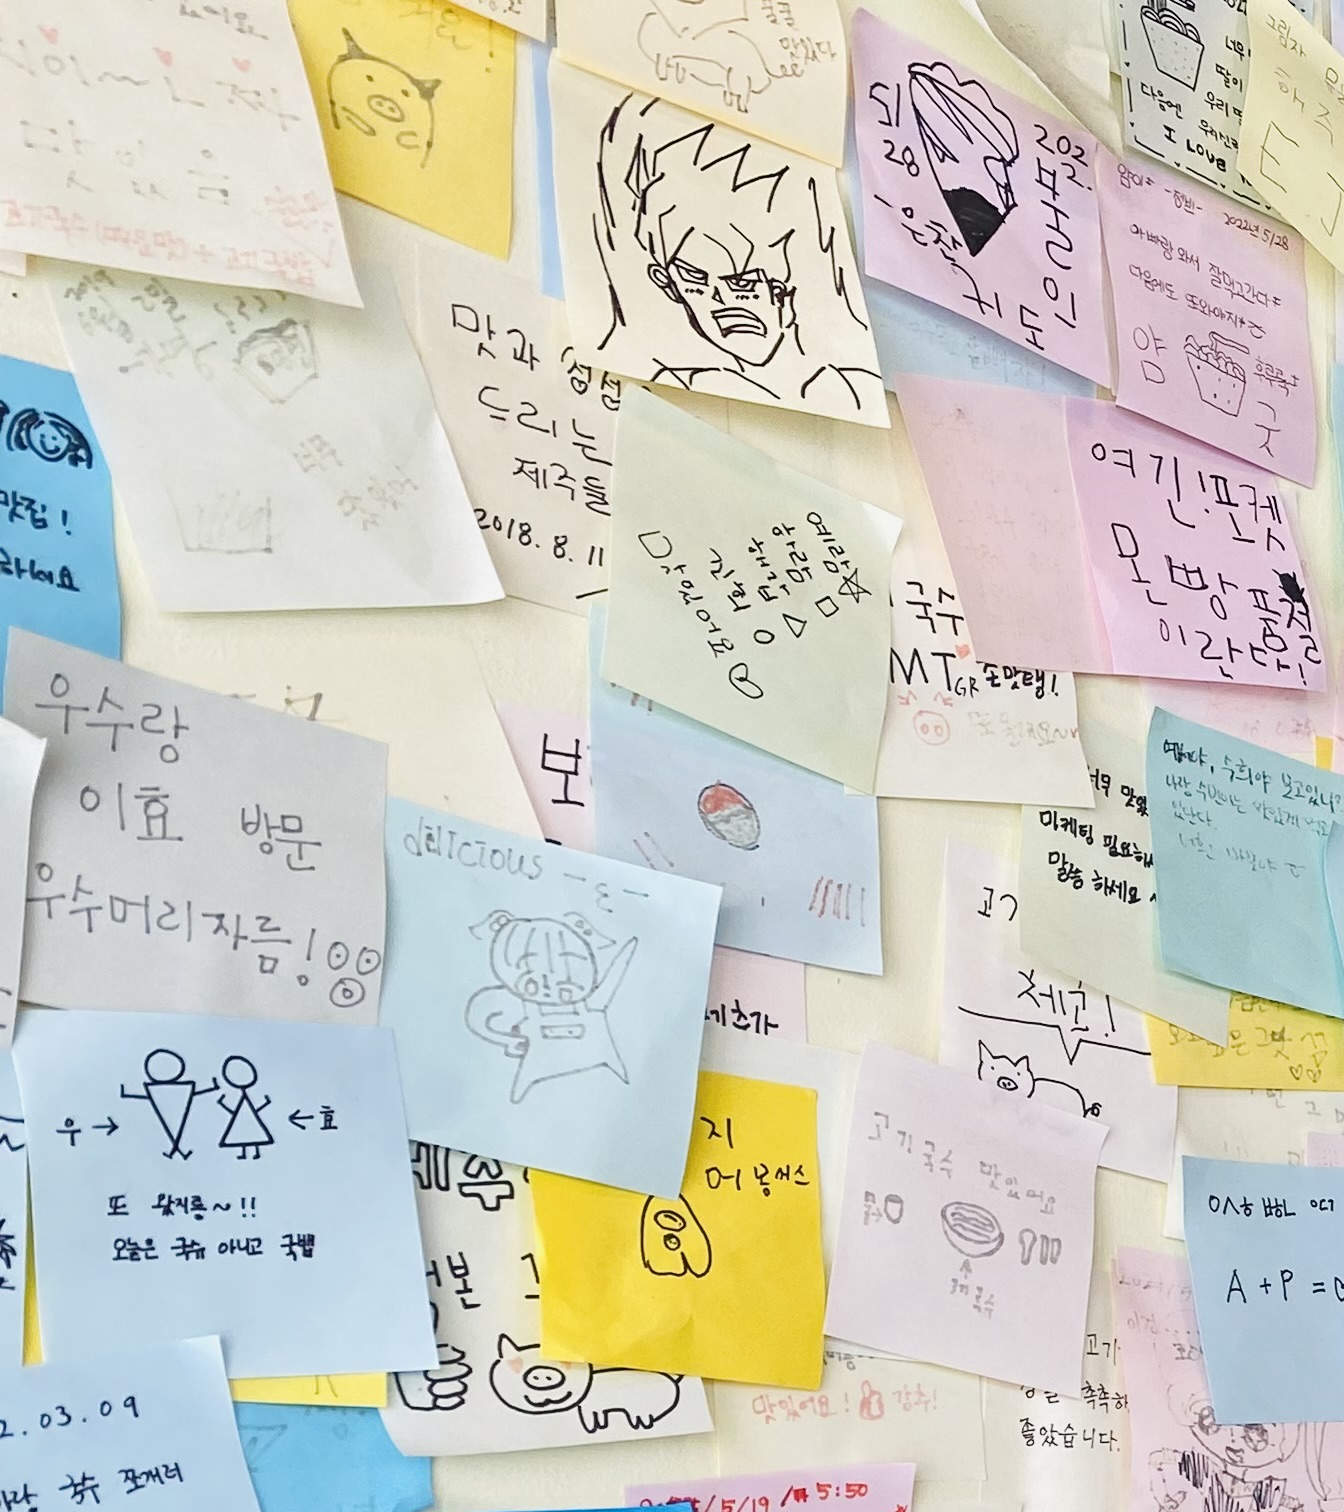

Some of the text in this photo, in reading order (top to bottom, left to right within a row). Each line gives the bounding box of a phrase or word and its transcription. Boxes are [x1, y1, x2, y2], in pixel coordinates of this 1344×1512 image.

[478, 385, 613, 466] 드리는
[906, 581, 964, 636] 국수
[35, 673, 189, 763] 우수랑
[80, 783, 321, 872] 이효 방문
[107, 1195, 129, 1216] 또
[218, 1238, 263, 1257] 아니고
[816, 1483, 867, 1500] 5:50
